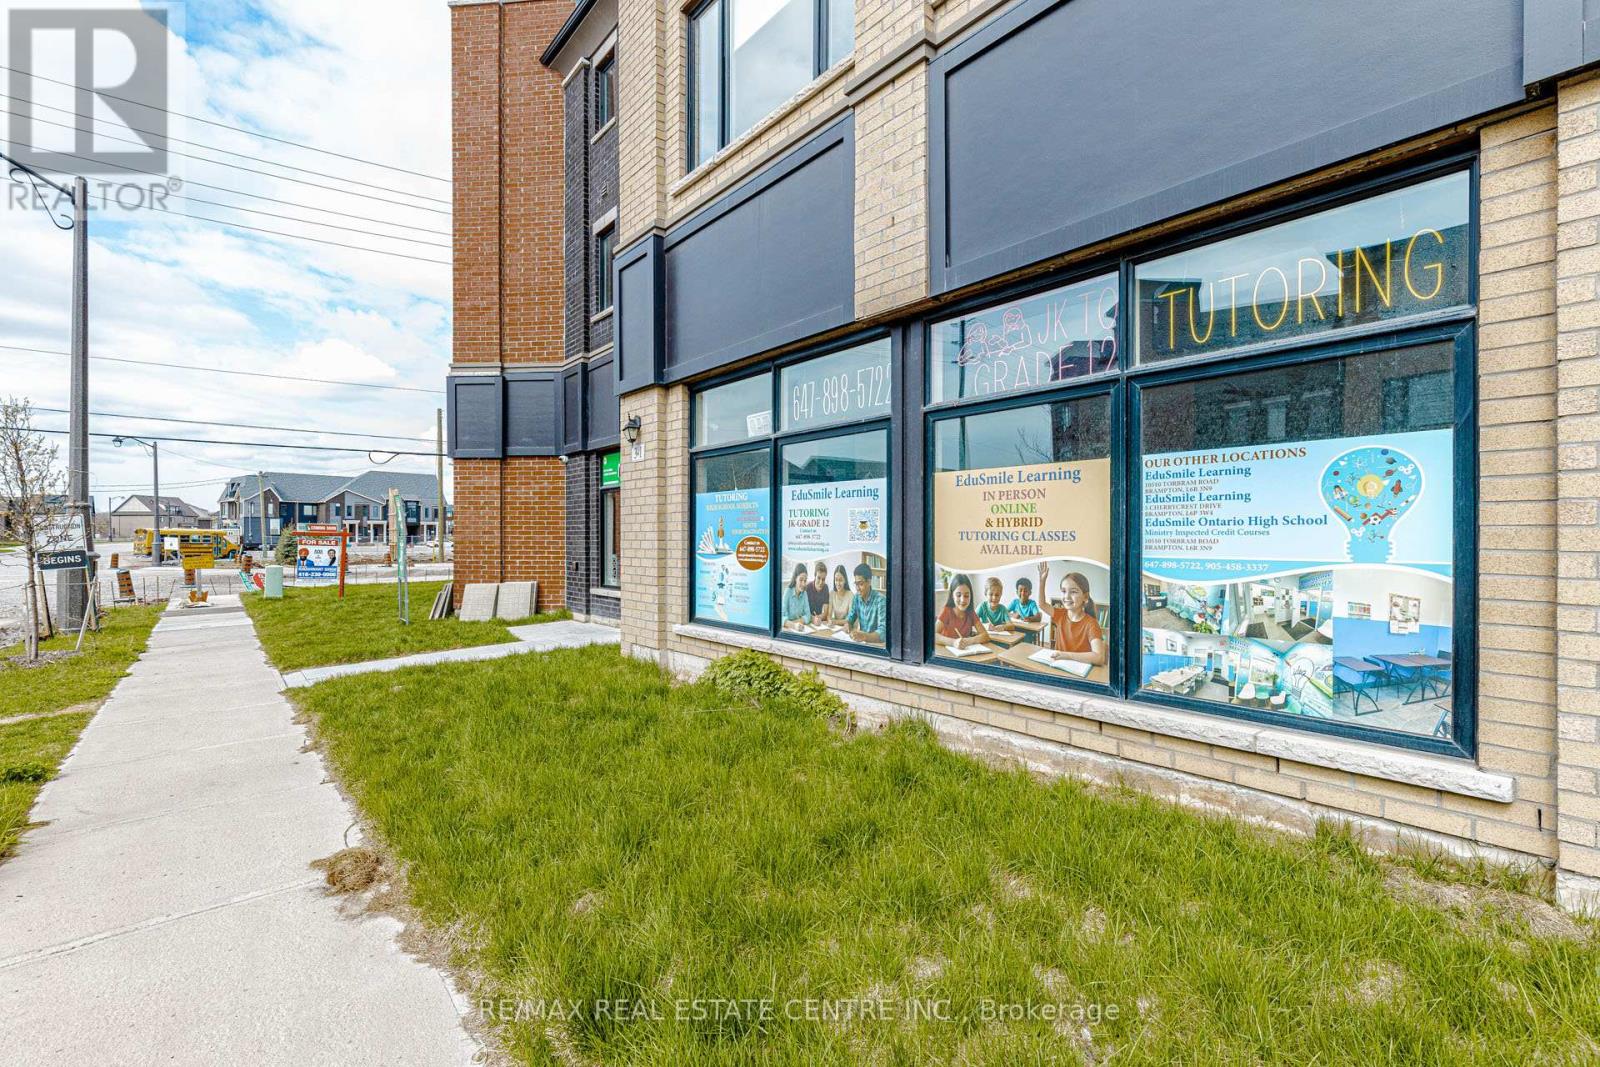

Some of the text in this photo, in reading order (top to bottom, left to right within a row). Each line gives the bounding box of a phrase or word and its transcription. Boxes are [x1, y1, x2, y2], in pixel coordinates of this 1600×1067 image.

[1157, 228, 1444, 350] TUTORING
[1037, 287, 1118, 344] JK TO
[1087, 335, 1117, 376] 12
[1144, 447, 1307, 469] OUR OTHER LOCATIONS
[956, 467, 1081, 487] EduSmile Learning
[1145, 466, 1251, 480] EduSmile Learning
[791, 485, 879, 501] EduSmile Learning
[983, 488, 1046, 501] IN PERSON
[1145, 490, 1251, 503] EduSmile Learning
[788, 508, 829, 518] TUTORING
[990, 503, 1037, 514] ONLINE
[788, 519, 830, 528] JK-GRADE 12
[985, 517, 1043, 528] & HYBRID
[1145, 514, 1328, 530] EduSmile Ontario High School
[958, 530, 1076, 542] TUTORING CLASSES
[1144, 528, 1270, 538] Ministry Inspected Credit Courses
[980, 545, 1043, 556] AVAILABLE
[43, 554, 82, 565] BEGINS
